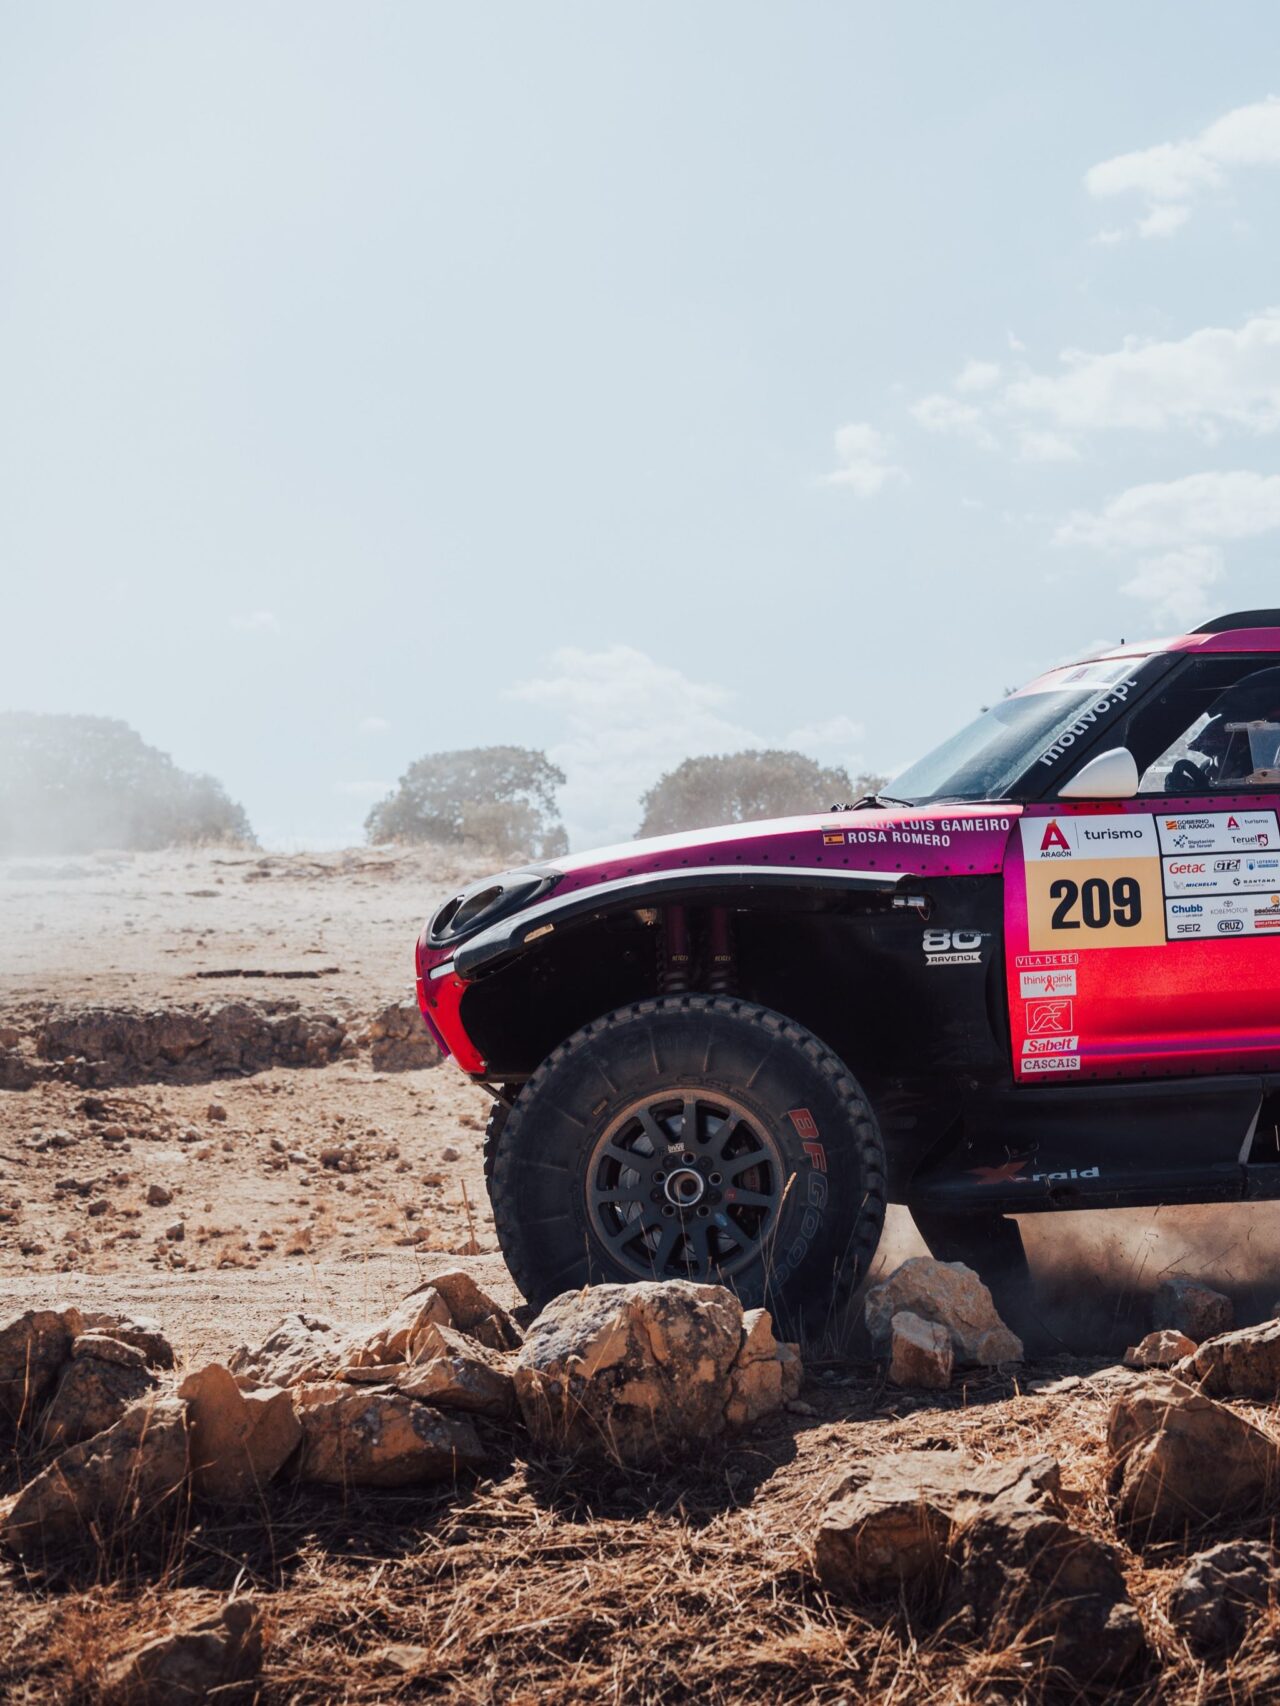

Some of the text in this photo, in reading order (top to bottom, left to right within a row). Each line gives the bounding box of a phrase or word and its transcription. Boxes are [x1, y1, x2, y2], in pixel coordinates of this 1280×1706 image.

[900, 819, 936, 831] LUIS
[941, 818, 1010, 832] GAMEIRO
[848, 831, 951, 847] ROSA ROMERO
[1084, 827, 1143, 841] turismo
[1232, 836, 1257, 844] Teruel
[1040, 850, 1072, 858] ARAGÓN
[1169, 862, 1206, 875] Getac
[1049, 876, 1143, 930] 209
[1171, 904, 1203, 914] Chubb
[1219, 921, 1240, 931] CRUZ
[922, 928, 982, 952] 80
[930, 954, 977, 963] RAVENOL
[1018, 955, 1078, 966] VILA DE REI
[1023, 973, 1072, 986] think pink
[1028, 1037, 1073, 1053] Sabelt
[1023, 1058, 1077, 1070] CASCAIS
